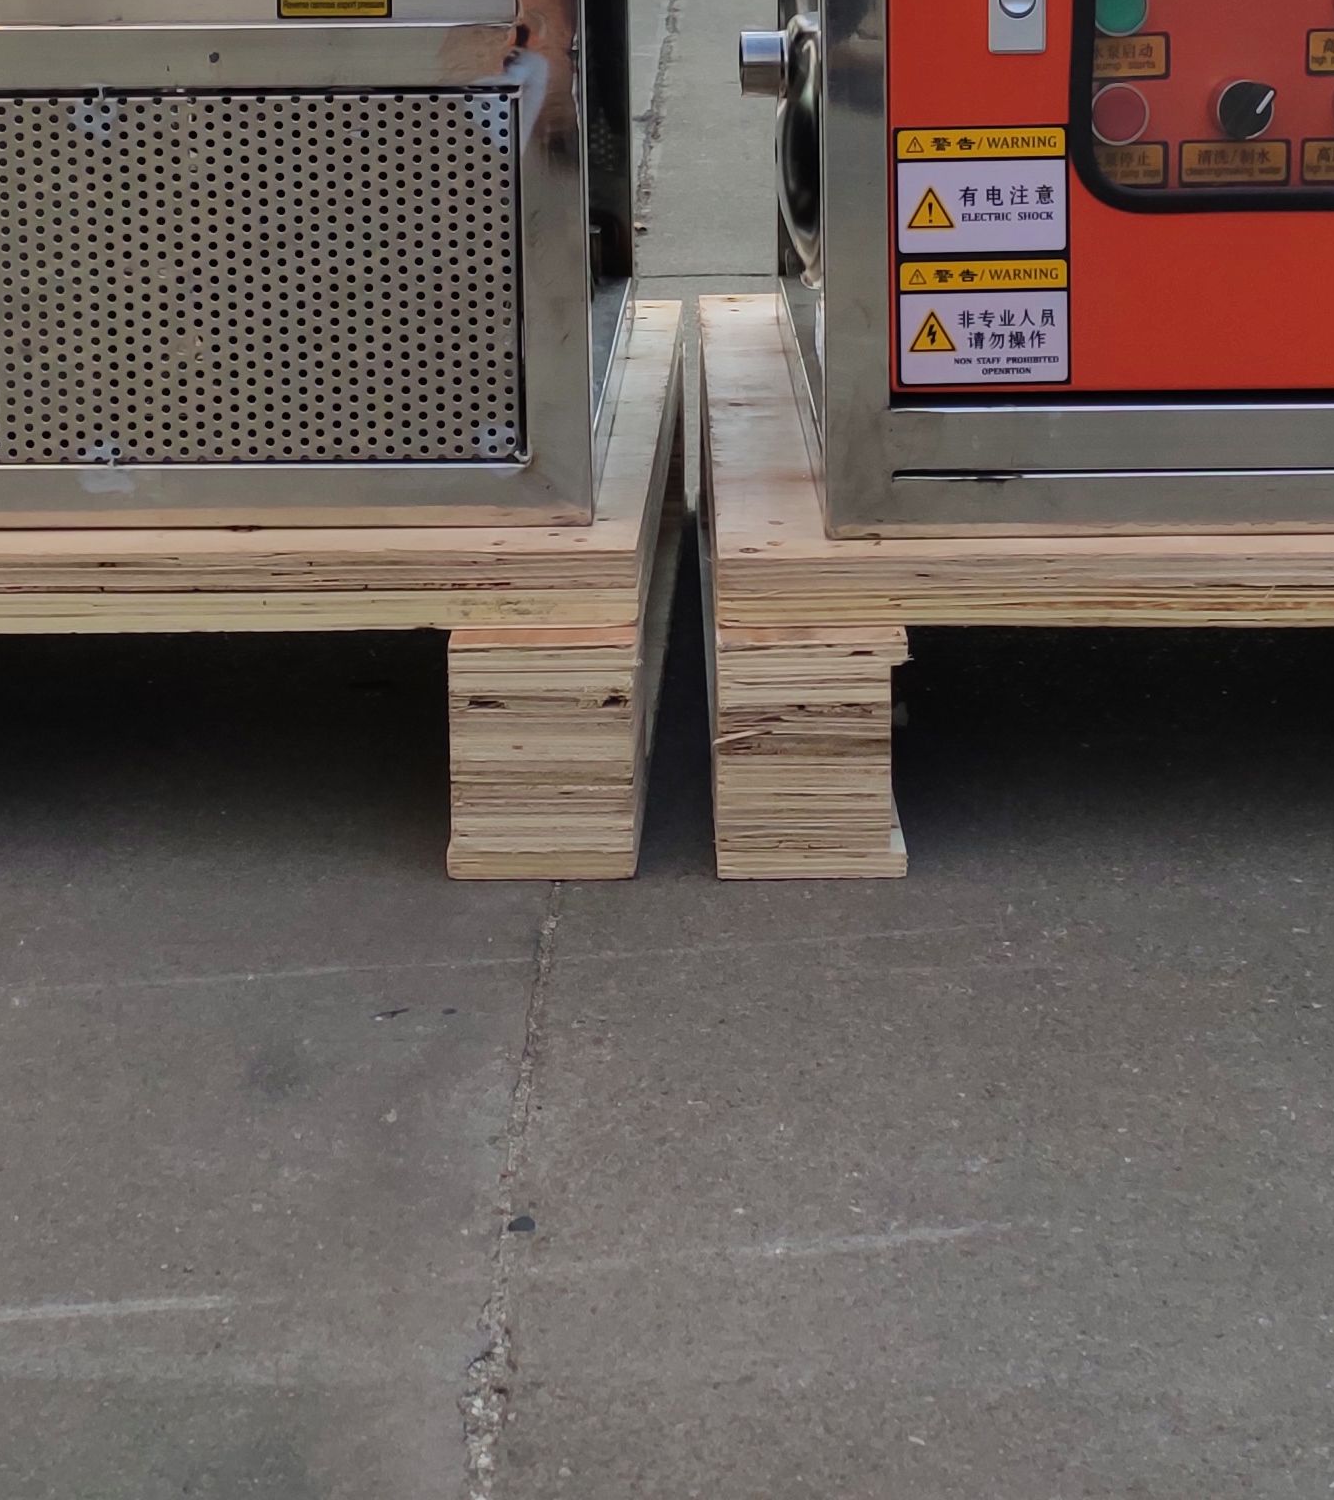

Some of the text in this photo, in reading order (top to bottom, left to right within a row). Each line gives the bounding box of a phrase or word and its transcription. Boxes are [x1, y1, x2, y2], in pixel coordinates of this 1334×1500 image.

[986, 135, 1057, 149] WARNING
[958, 184, 1054, 207] 有电注意
[961, 211, 1054, 222] ELECTRIC SHOCK
[989, 268, 1059, 281] WARNING
[957, 309, 1056, 329] 非专业人员
[968, 331, 1046, 350] 请勿操作
[954, 357, 972, 365] NON
[1006, 355, 1059, 364] PROHIBITED
